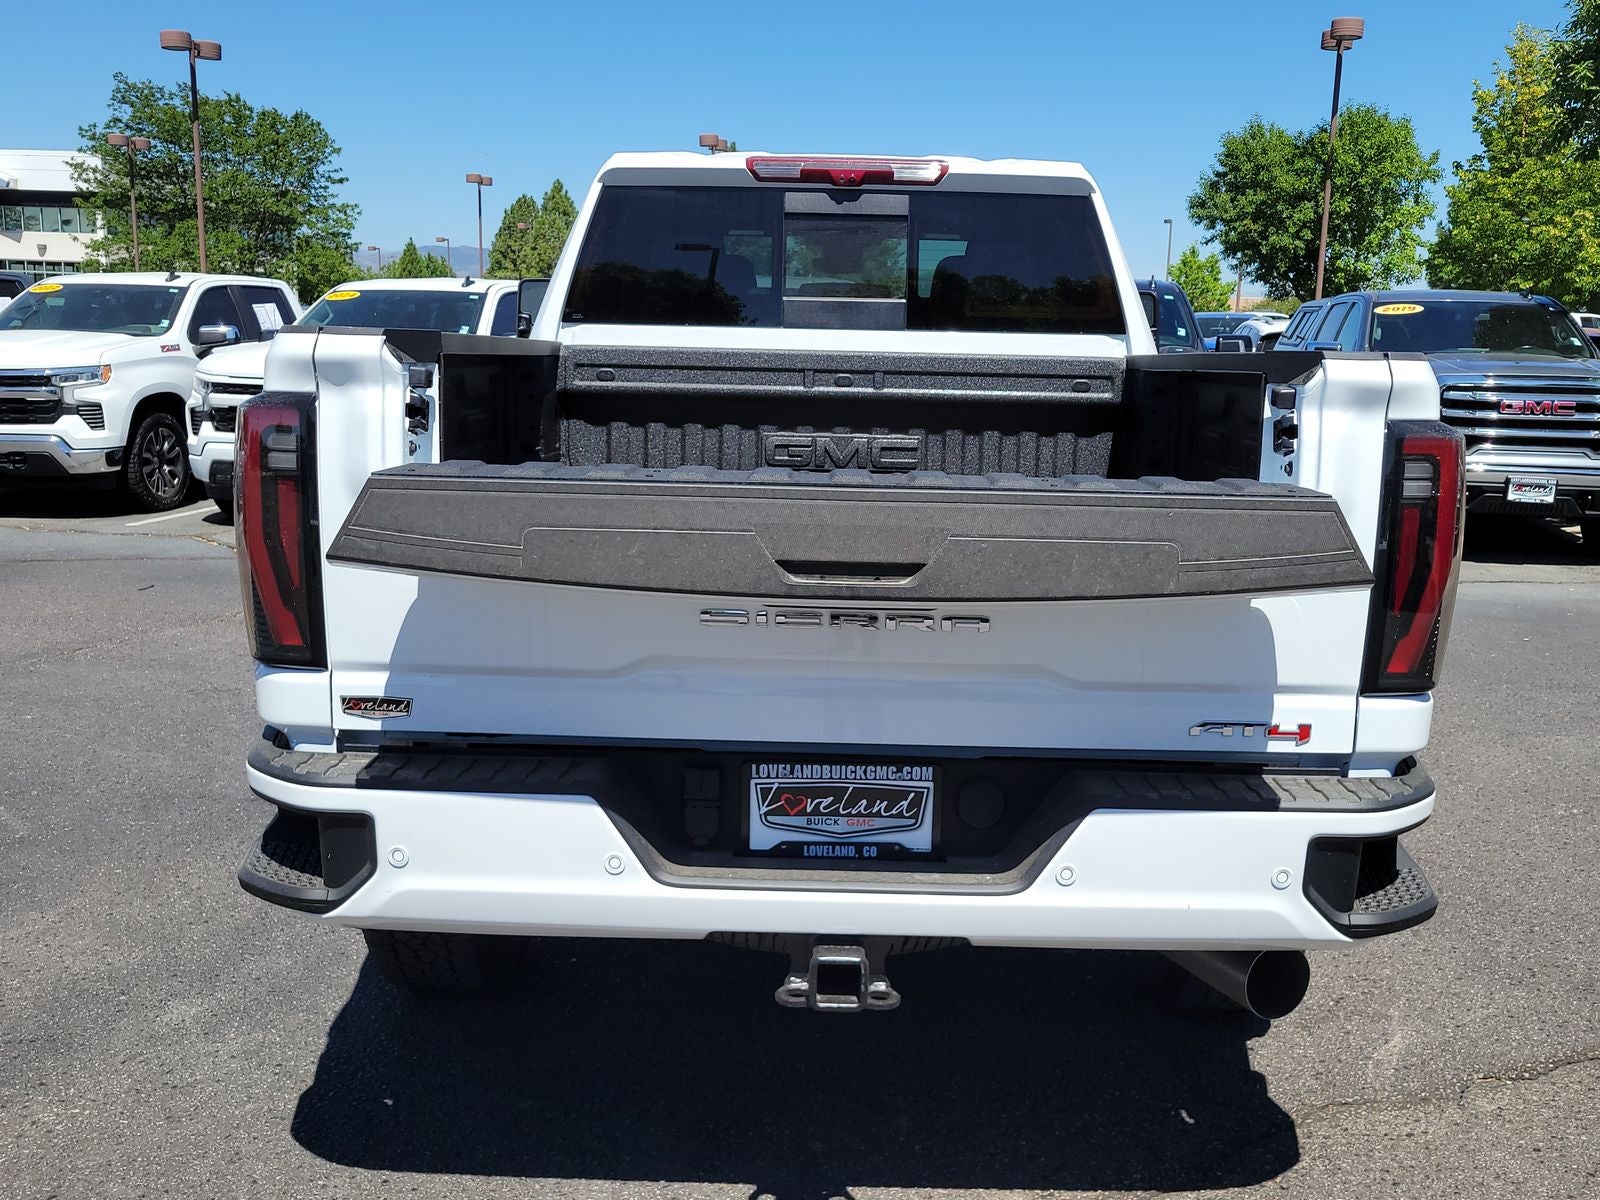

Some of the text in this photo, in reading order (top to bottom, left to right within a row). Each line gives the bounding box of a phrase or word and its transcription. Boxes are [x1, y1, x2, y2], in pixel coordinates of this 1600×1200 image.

[1500, 400, 1576, 416] GMC
[765, 436, 919, 469] GMC
[700, 608, 991, 633] SIERRA
[1189, 720, 1312, 747] AT4
[751, 763, 933, 781] LOVELANDBUICKGMC.COM
[760, 783, 918, 817] Loveland
[806, 817, 876, 827] BUICK GMC
[803, 845, 877, 858] LOVELAND, CO
